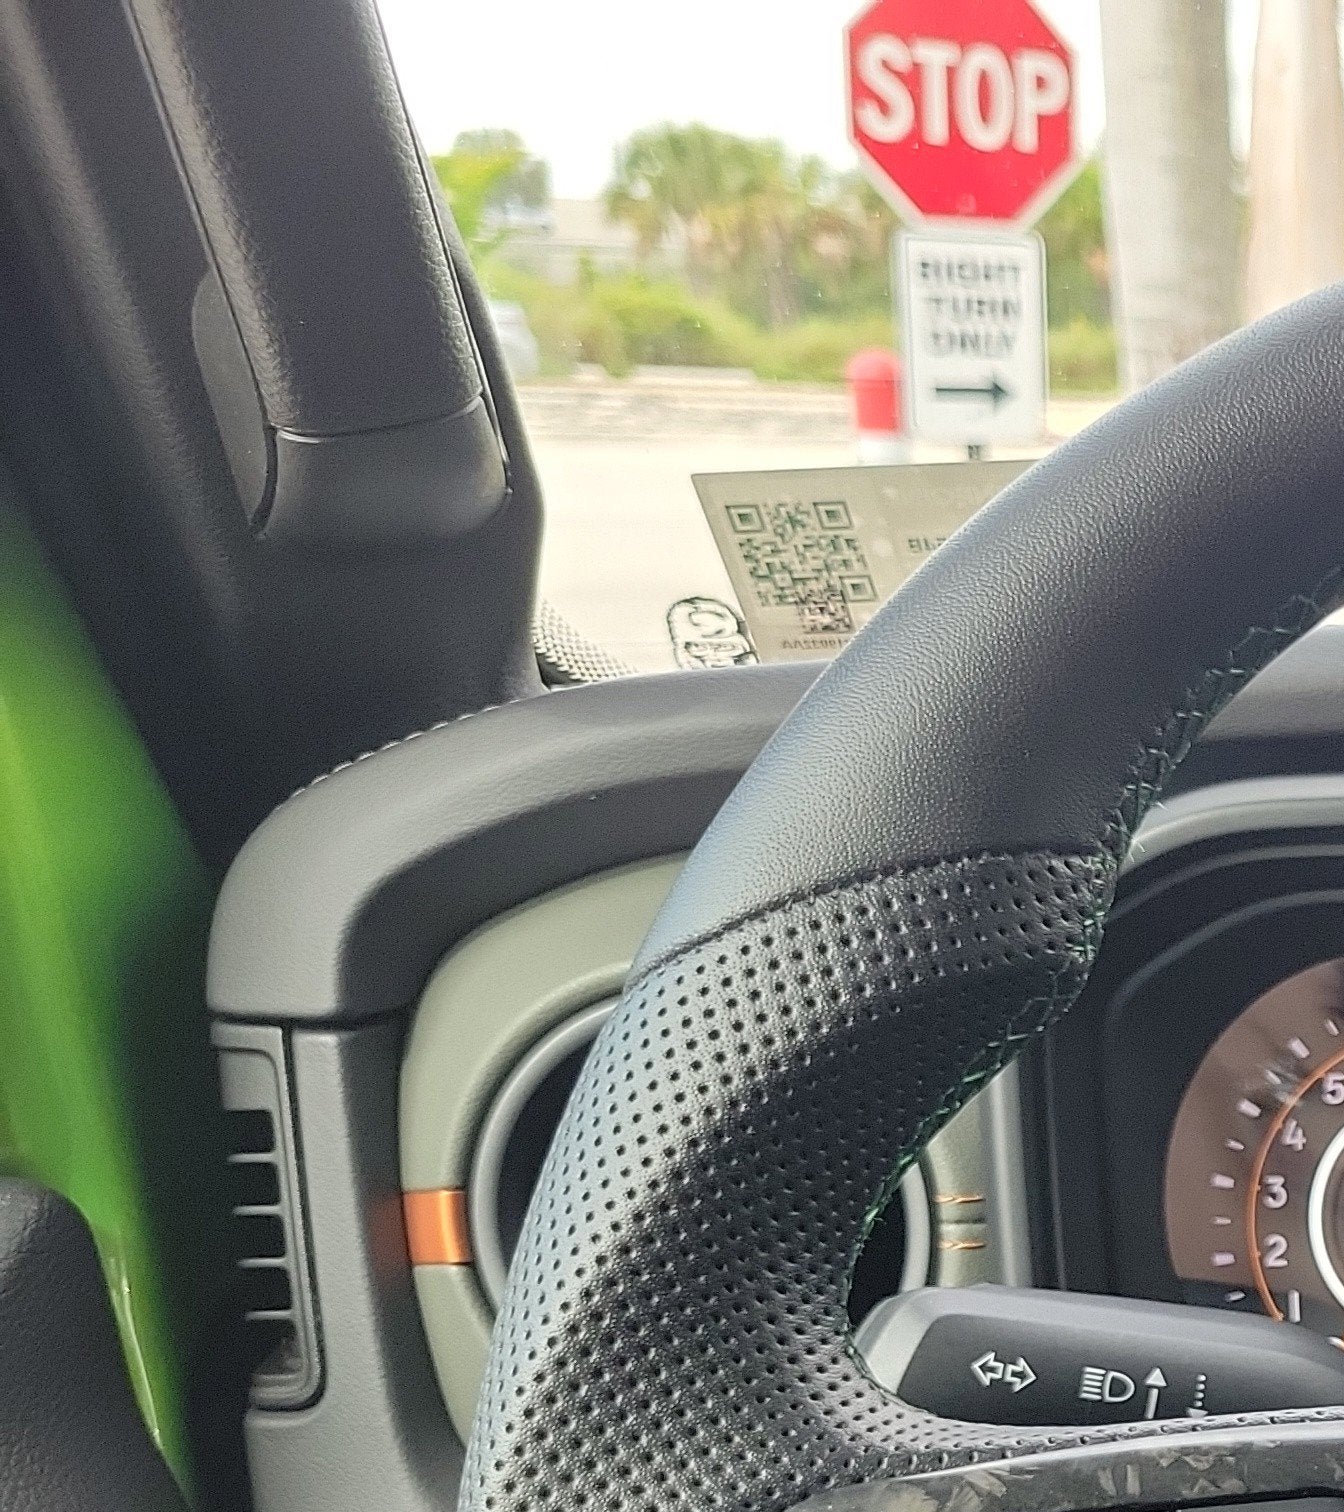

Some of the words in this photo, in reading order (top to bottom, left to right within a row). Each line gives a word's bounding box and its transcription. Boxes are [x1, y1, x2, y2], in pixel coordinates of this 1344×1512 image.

[853, 32, 1070, 154] STOP
[918, 259, 1021, 282] RIGHT
[926, 296, 1021, 318] TURN
[931, 330, 1016, 353] ONLY
[1281, 1118, 1306, 1151] 4
[1263, 1174, 1288, 1209] 3
[1262, 1233, 1288, 1268] 2
[1287, 1289, 1300, 1323] 1
